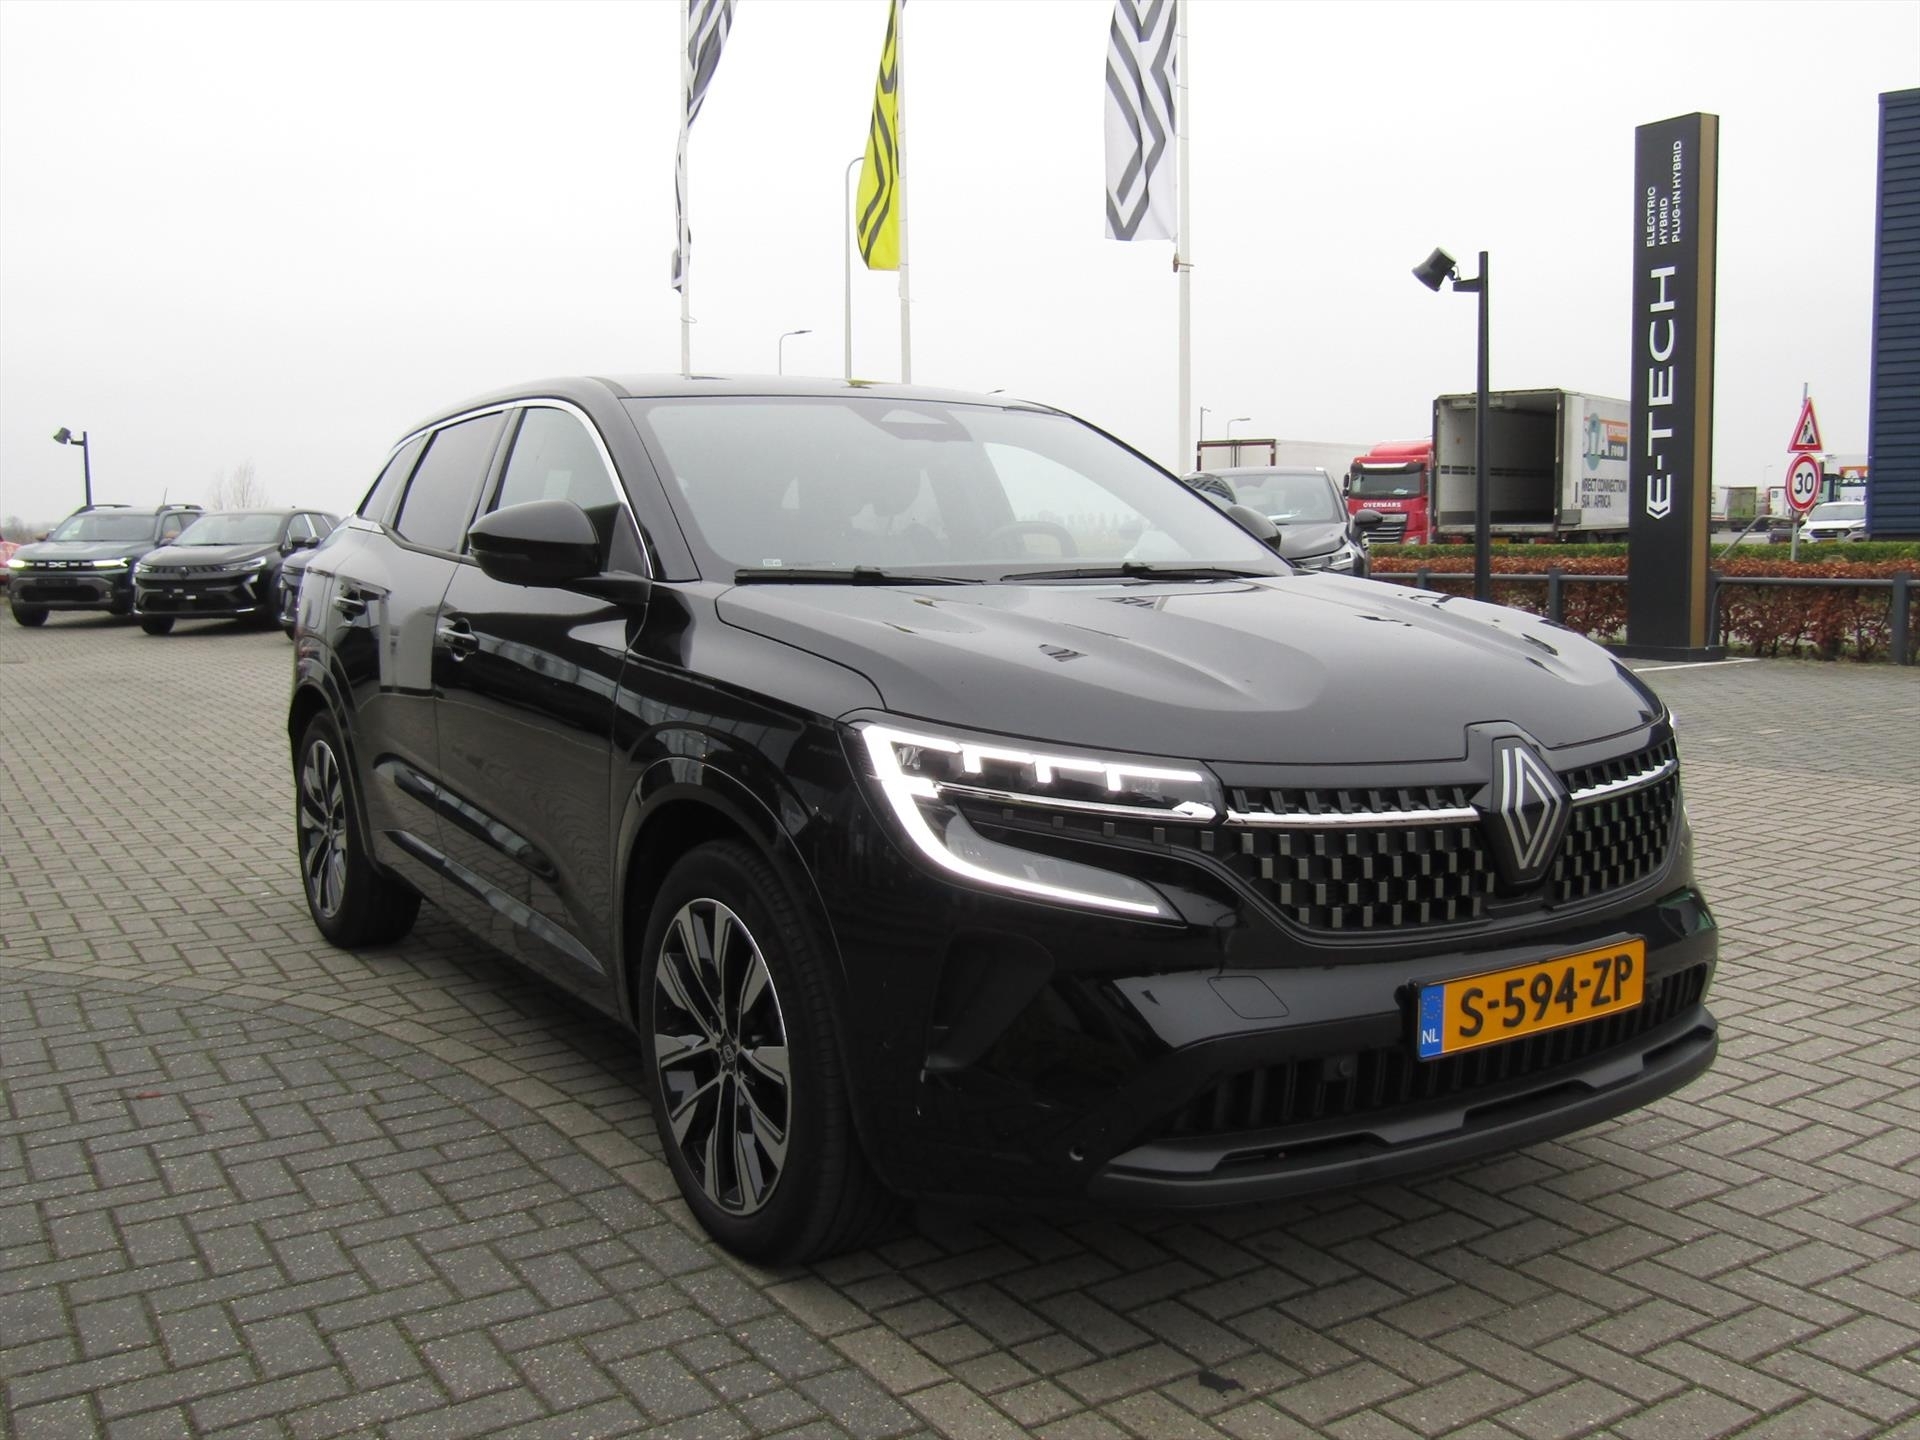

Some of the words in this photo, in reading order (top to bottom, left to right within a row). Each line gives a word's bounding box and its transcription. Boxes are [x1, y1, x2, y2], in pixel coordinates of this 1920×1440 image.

[1672, 140, 1682, 189] HYBRID
[1646, 186, 1656, 247] ELECTRIC
[1659, 197, 1668, 245] HYBRID
[1671, 190, 1681, 243] PLUG-IN
[1646, 266, 1675, 520] E-TECH
[1581, 494, 1590, 508] SIA
[1594, 494, 1611, 509] AFRICA
[1794, 472, 1814, 495] 30
[1458, 953, 1634, 1038] S-594-ZP
[1421, 1027, 1439, 1045] NL
